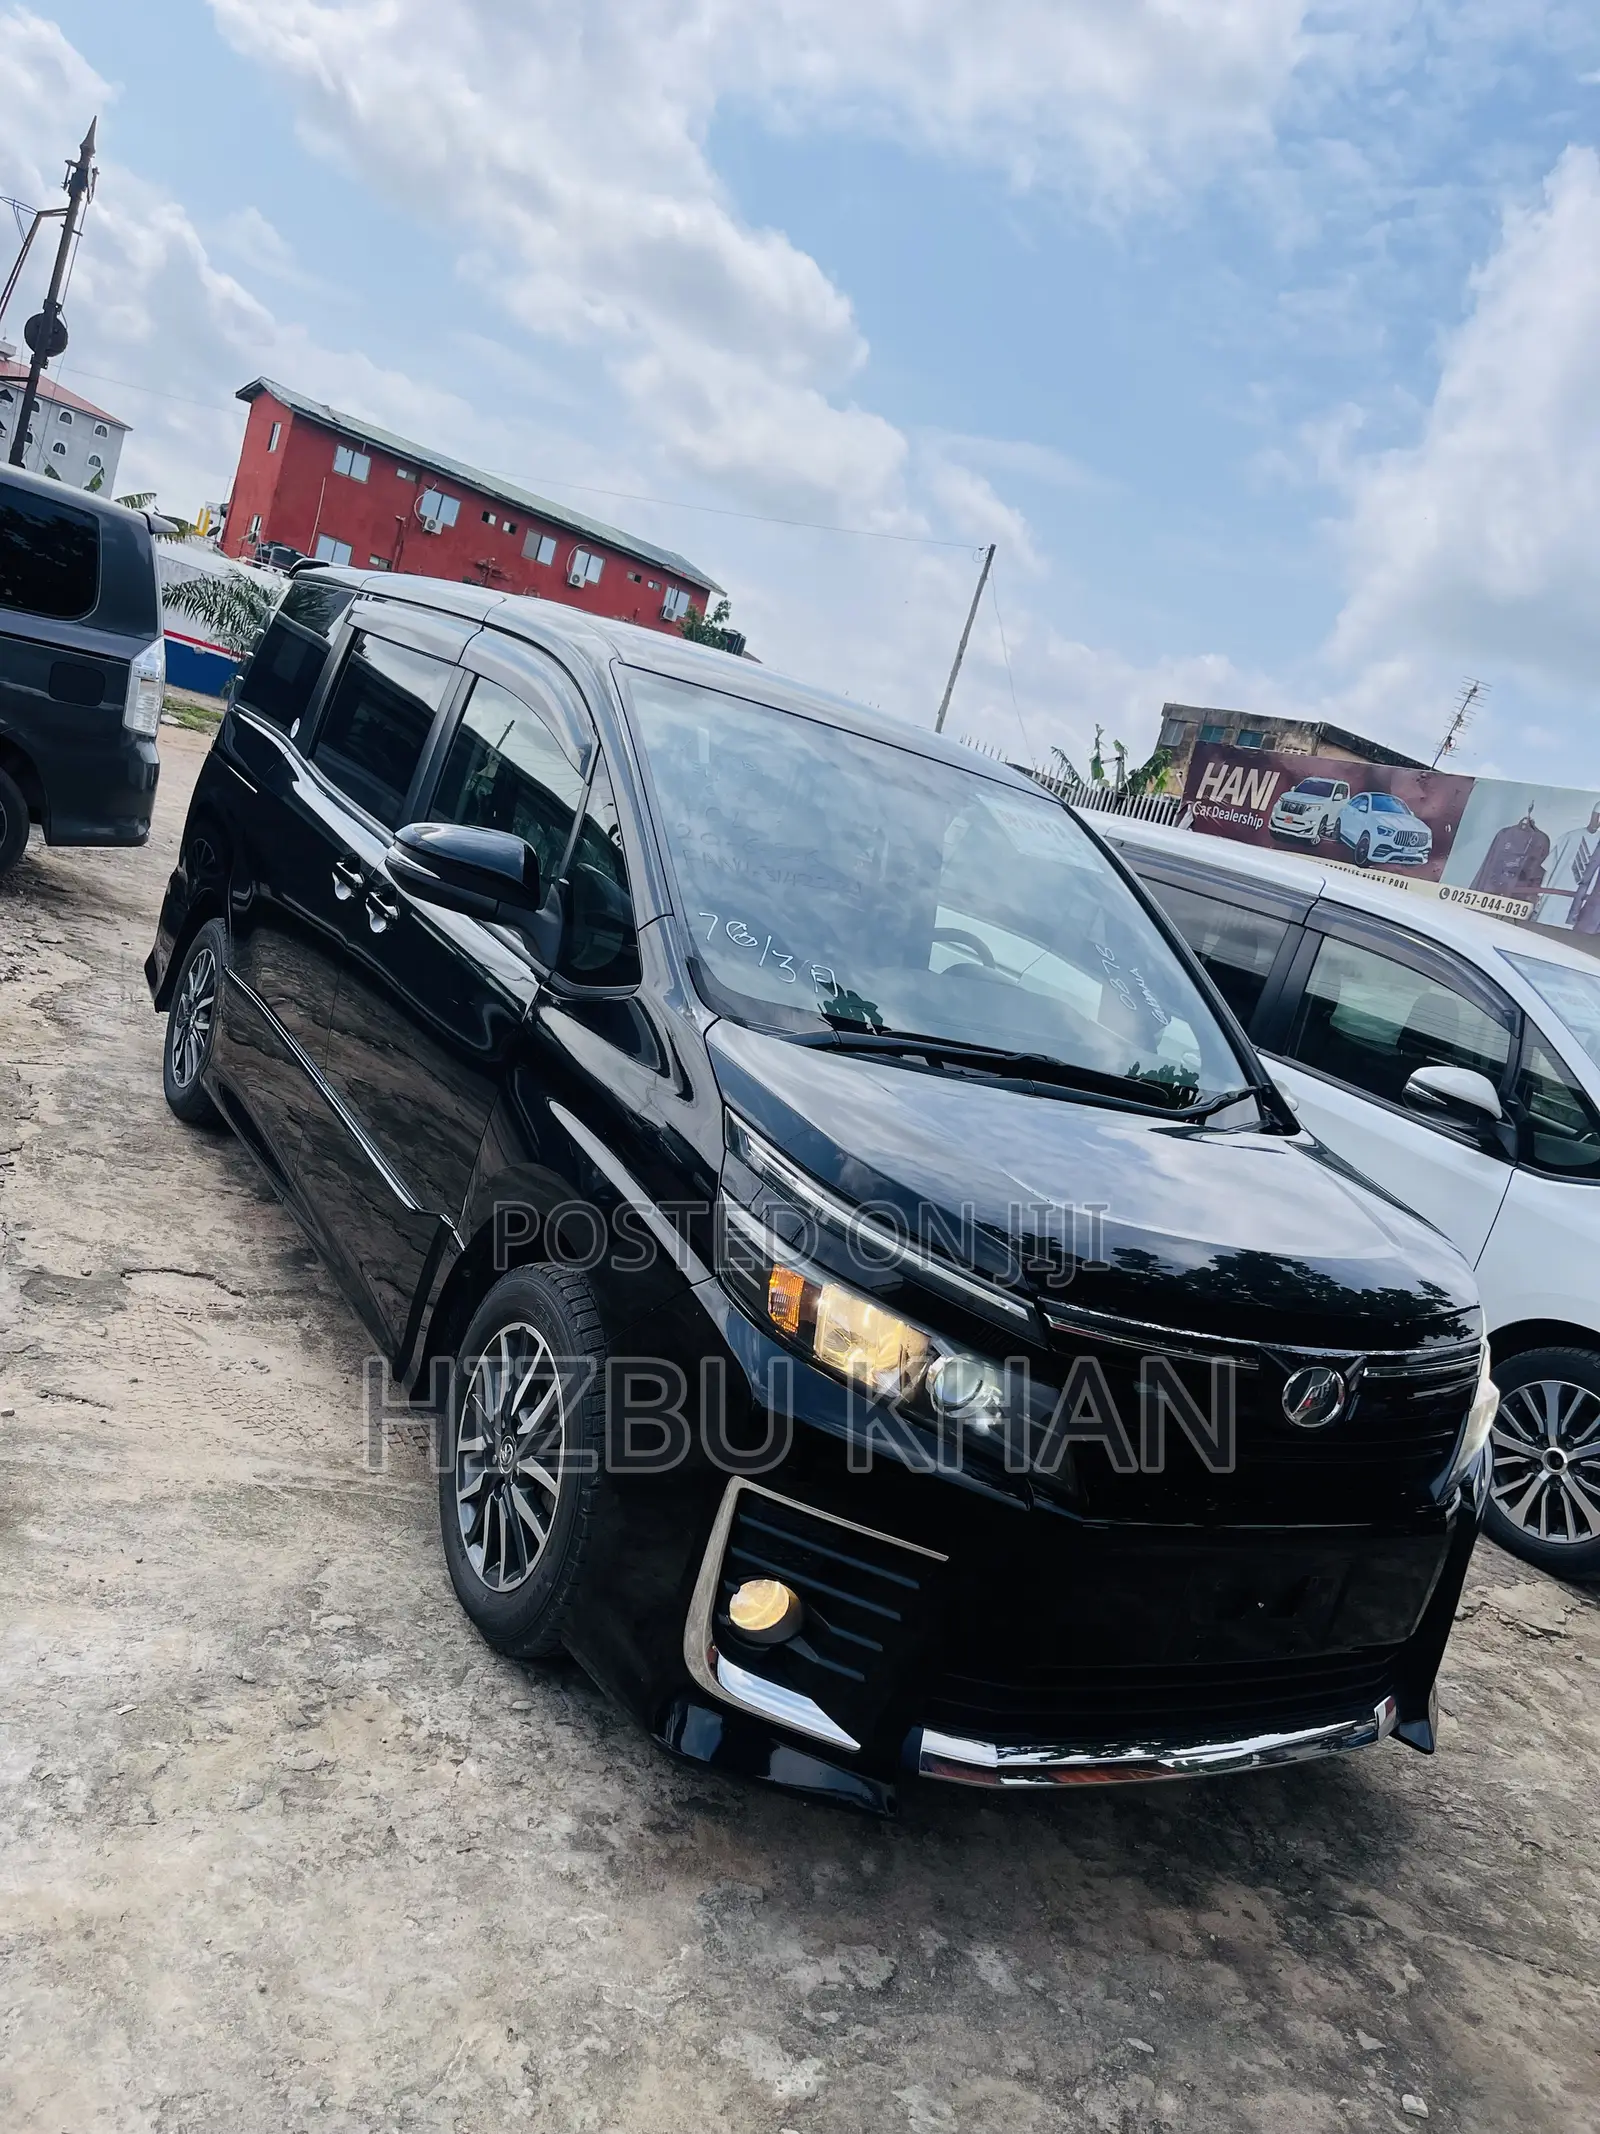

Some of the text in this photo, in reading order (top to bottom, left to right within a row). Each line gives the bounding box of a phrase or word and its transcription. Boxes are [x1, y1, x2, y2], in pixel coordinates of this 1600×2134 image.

[1195, 762, 1281, 812] HANI
[1193, 801, 1264, 830] Car Dealership
[1388, 878, 1409, 890] POOL
[1451, 889, 1529, 918] 0257-044-039
